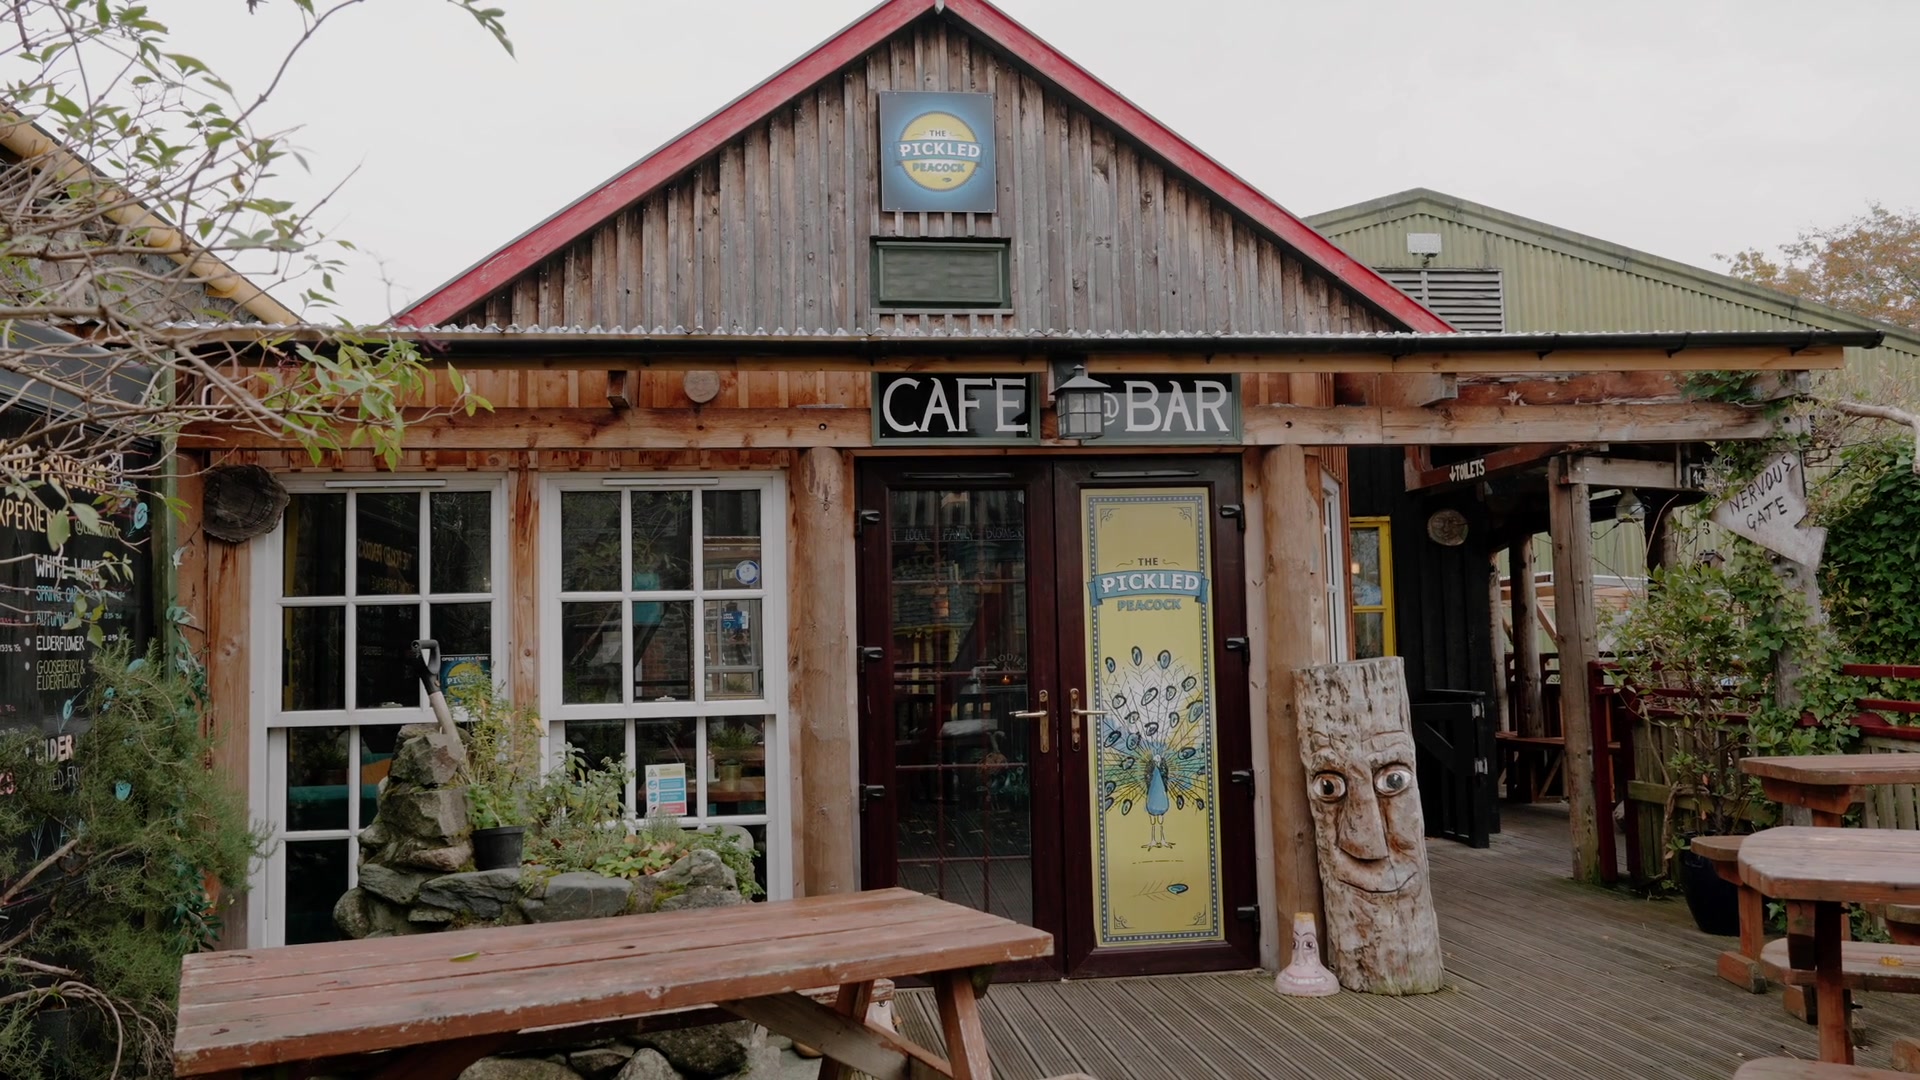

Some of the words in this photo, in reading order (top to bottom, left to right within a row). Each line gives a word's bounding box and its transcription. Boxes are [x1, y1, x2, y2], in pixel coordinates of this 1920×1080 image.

[900, 142, 980, 157] PICKLED
[912, 162, 965, 172] PEACOCK
[882, 377, 1029, 432] CAFE
[1123, 379, 1230, 432] BAR
[1454, 458, 1486, 481] TOILETS
[1728, 456, 1791, 515] NERVOUS
[1746, 496, 1788, 532] GATE
[35, 554, 69, 580] WHITE
[1138, 558, 1159, 567] THE
[1101, 573, 1200, 594] PICKLED
[1117, 599, 1182, 612] PEACOCK
[36, 635, 85, 651] ELDERFLOWER
[36, 659, 80, 675] GOOSEBERRY
[80, 658, 87, 675] &
[36, 672, 83, 691] ELDERFLOWER
